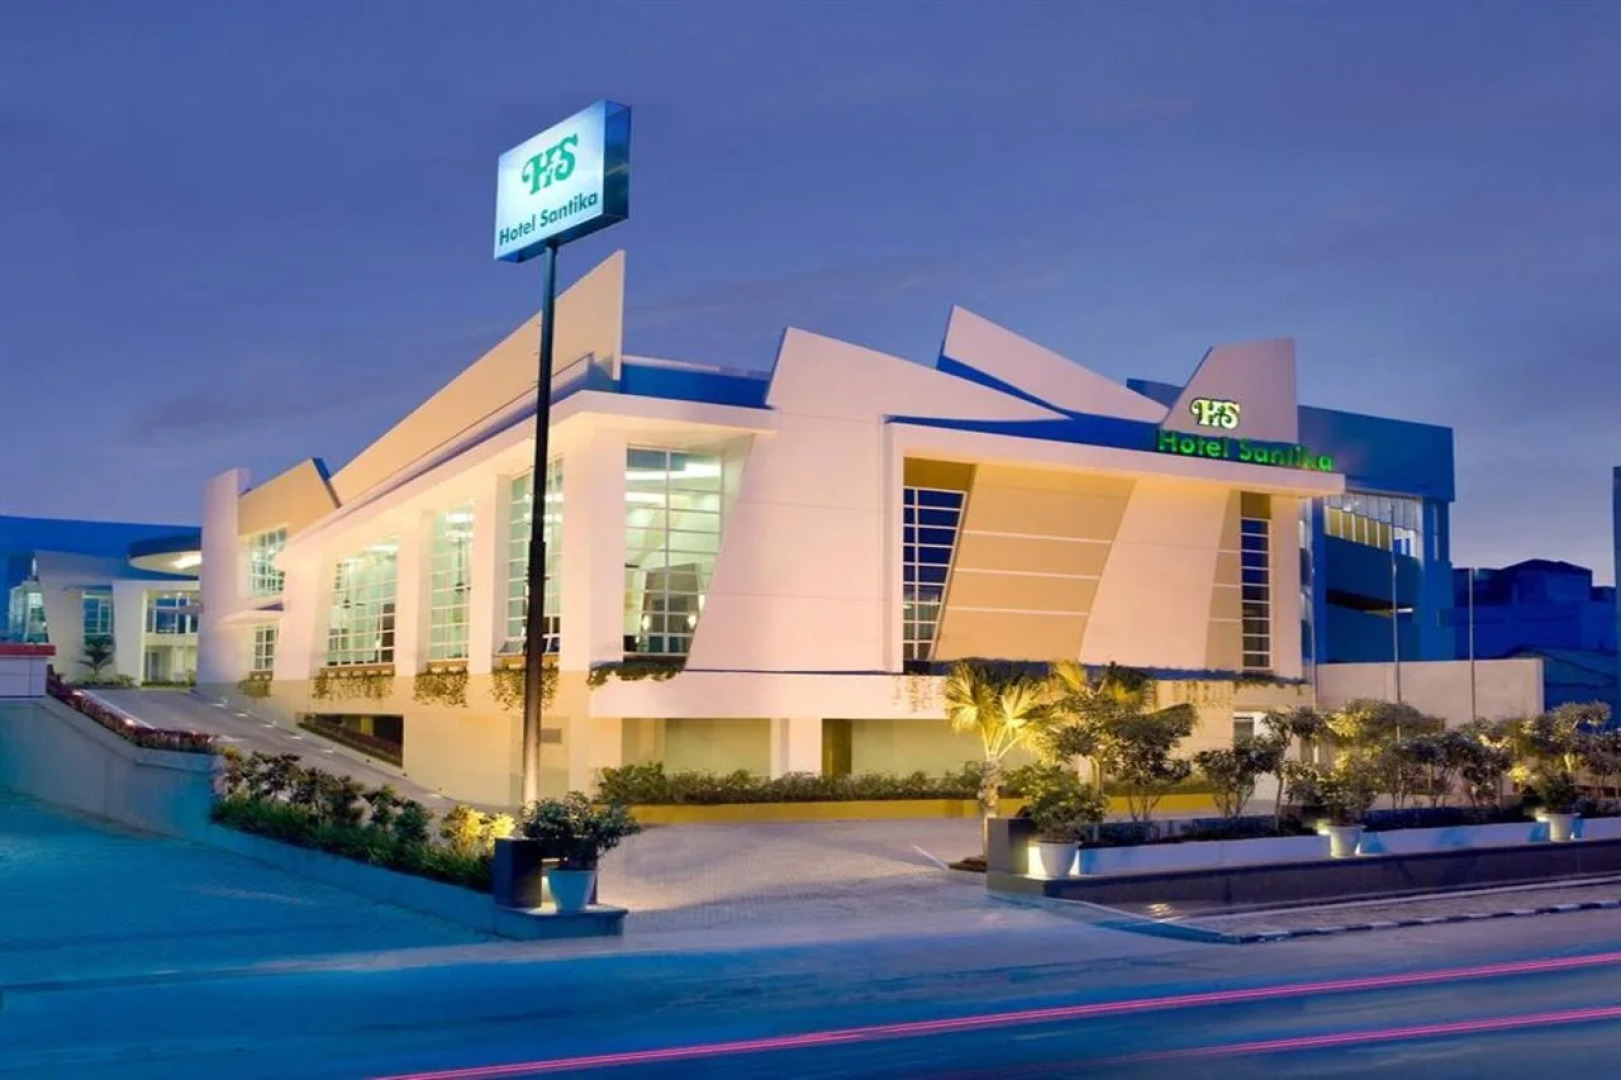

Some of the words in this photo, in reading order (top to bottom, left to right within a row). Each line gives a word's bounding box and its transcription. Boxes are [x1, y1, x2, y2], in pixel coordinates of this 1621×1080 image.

[521, 133, 578, 195] HS
[499, 214, 536, 246] Hotel
[540, 192, 598, 227] Santika
[1190, 398, 1241, 430] HS
[1158, 430, 1229, 458] Hotel
[1239, 438, 1333, 472] Santika
